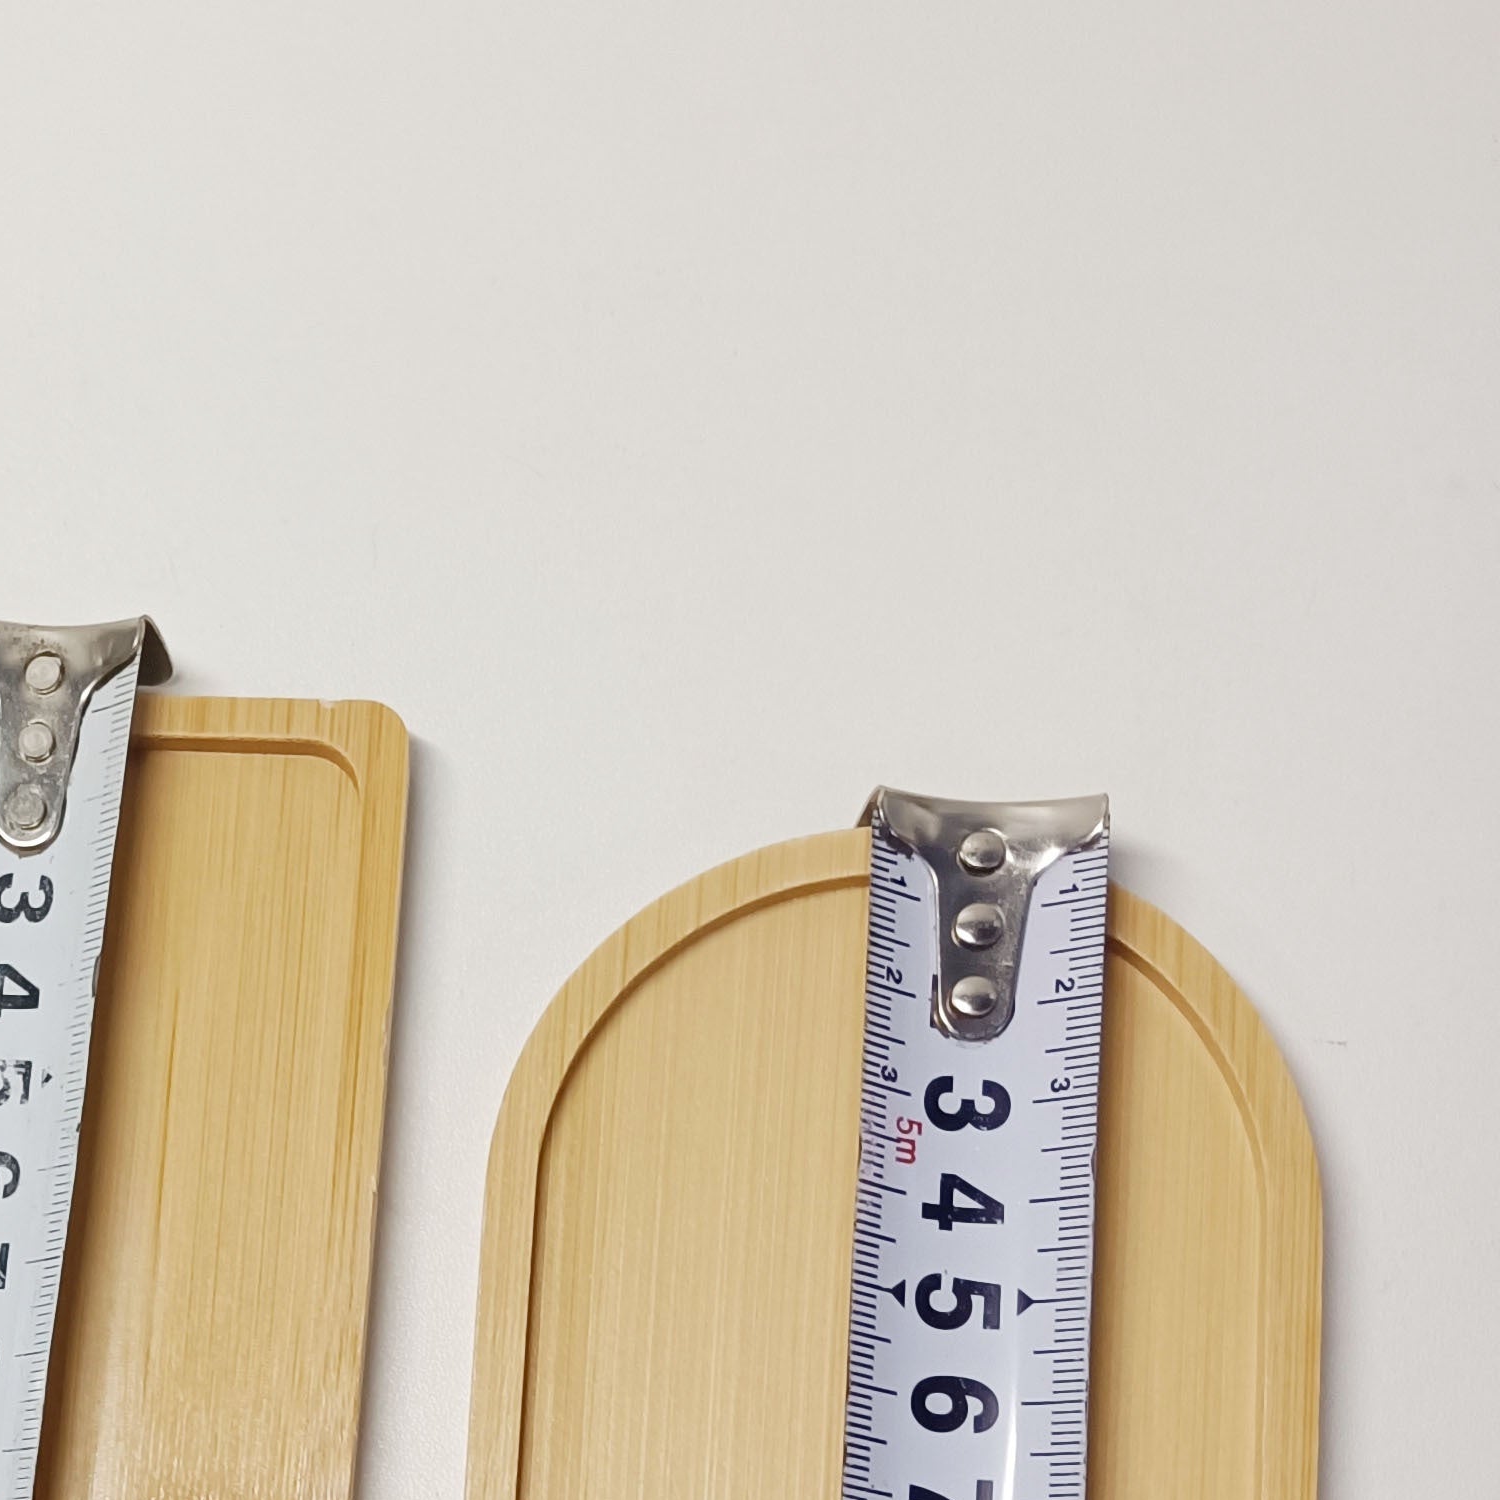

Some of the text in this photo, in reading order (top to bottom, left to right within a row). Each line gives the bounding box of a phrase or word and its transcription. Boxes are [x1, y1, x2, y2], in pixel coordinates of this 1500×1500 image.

[885, 969, 903, 986] 2
[1050, 883, 1079, 1093] 1 2 3
[880, 1065, 898, 1083] 3
[923, 1075, 1011, 1132] 3
[895, 1115, 922, 1165] 5m
[921, 1173, 1004, 1231] 4
[914, 1272, 1001, 1330] 5
[910, 1375, 999, 1434] 6
